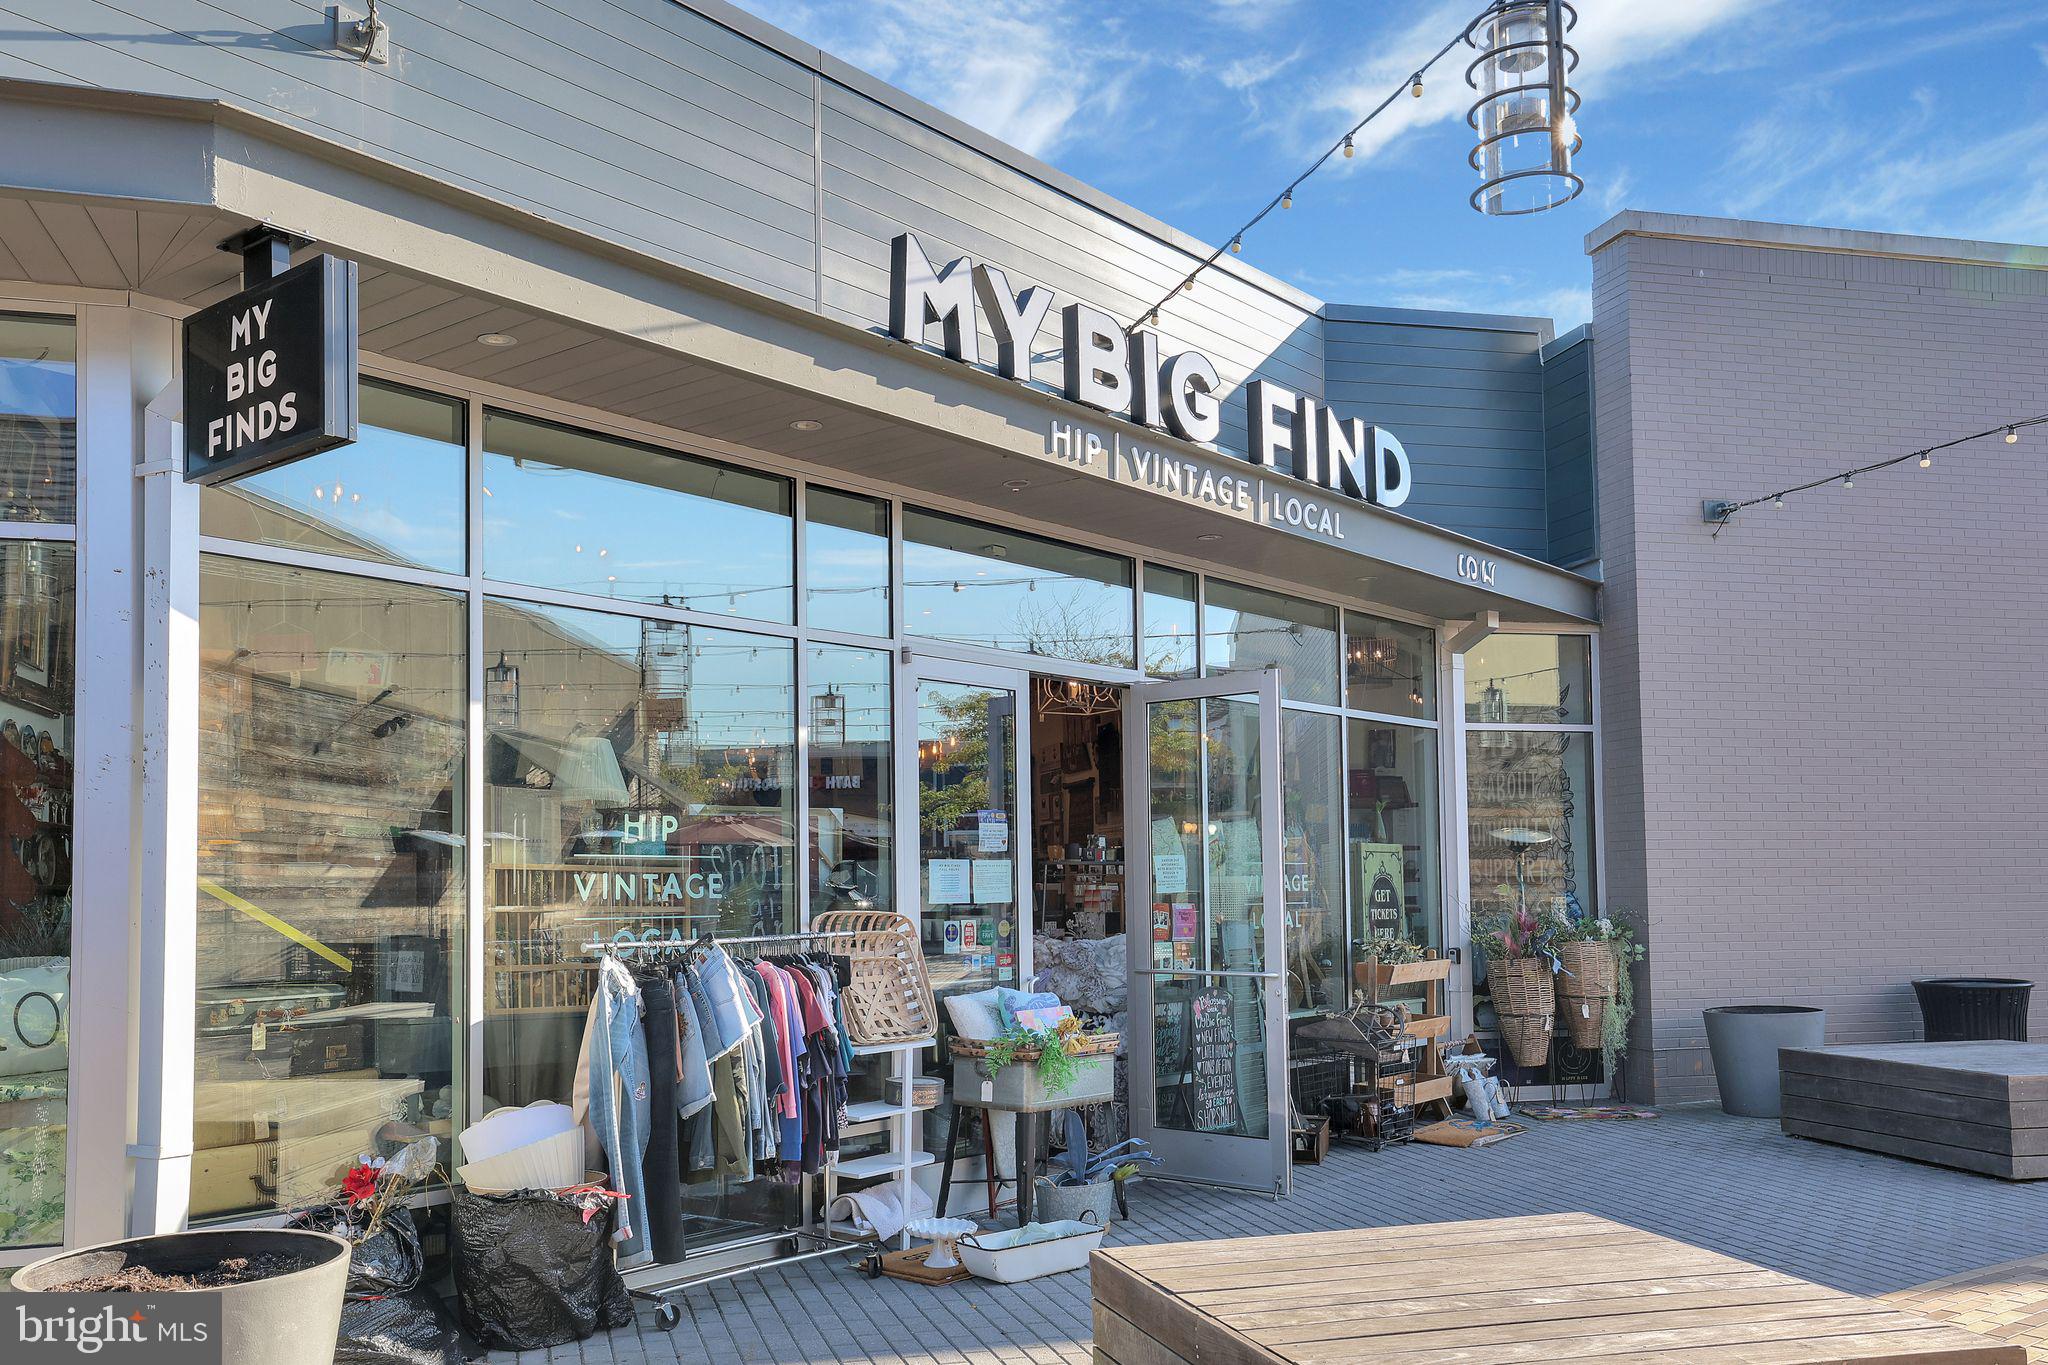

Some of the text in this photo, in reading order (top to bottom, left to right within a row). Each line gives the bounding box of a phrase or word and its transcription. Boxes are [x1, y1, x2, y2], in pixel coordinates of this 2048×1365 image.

[230, 298, 273, 352] MY
[226, 349, 277, 402] BIG
[889, 231, 1411, 508] MY BIG FIND
[208, 391, 298, 458] FINDS
[1050, 420, 1345, 540] HIP VINTAGE LOCAL
[624, 813, 679, 842] HIP
[573, 872, 724, 902] VINTAGE
[1374, 889, 1391, 903] GET
[1370, 908, 1398, 920] TICKETS
